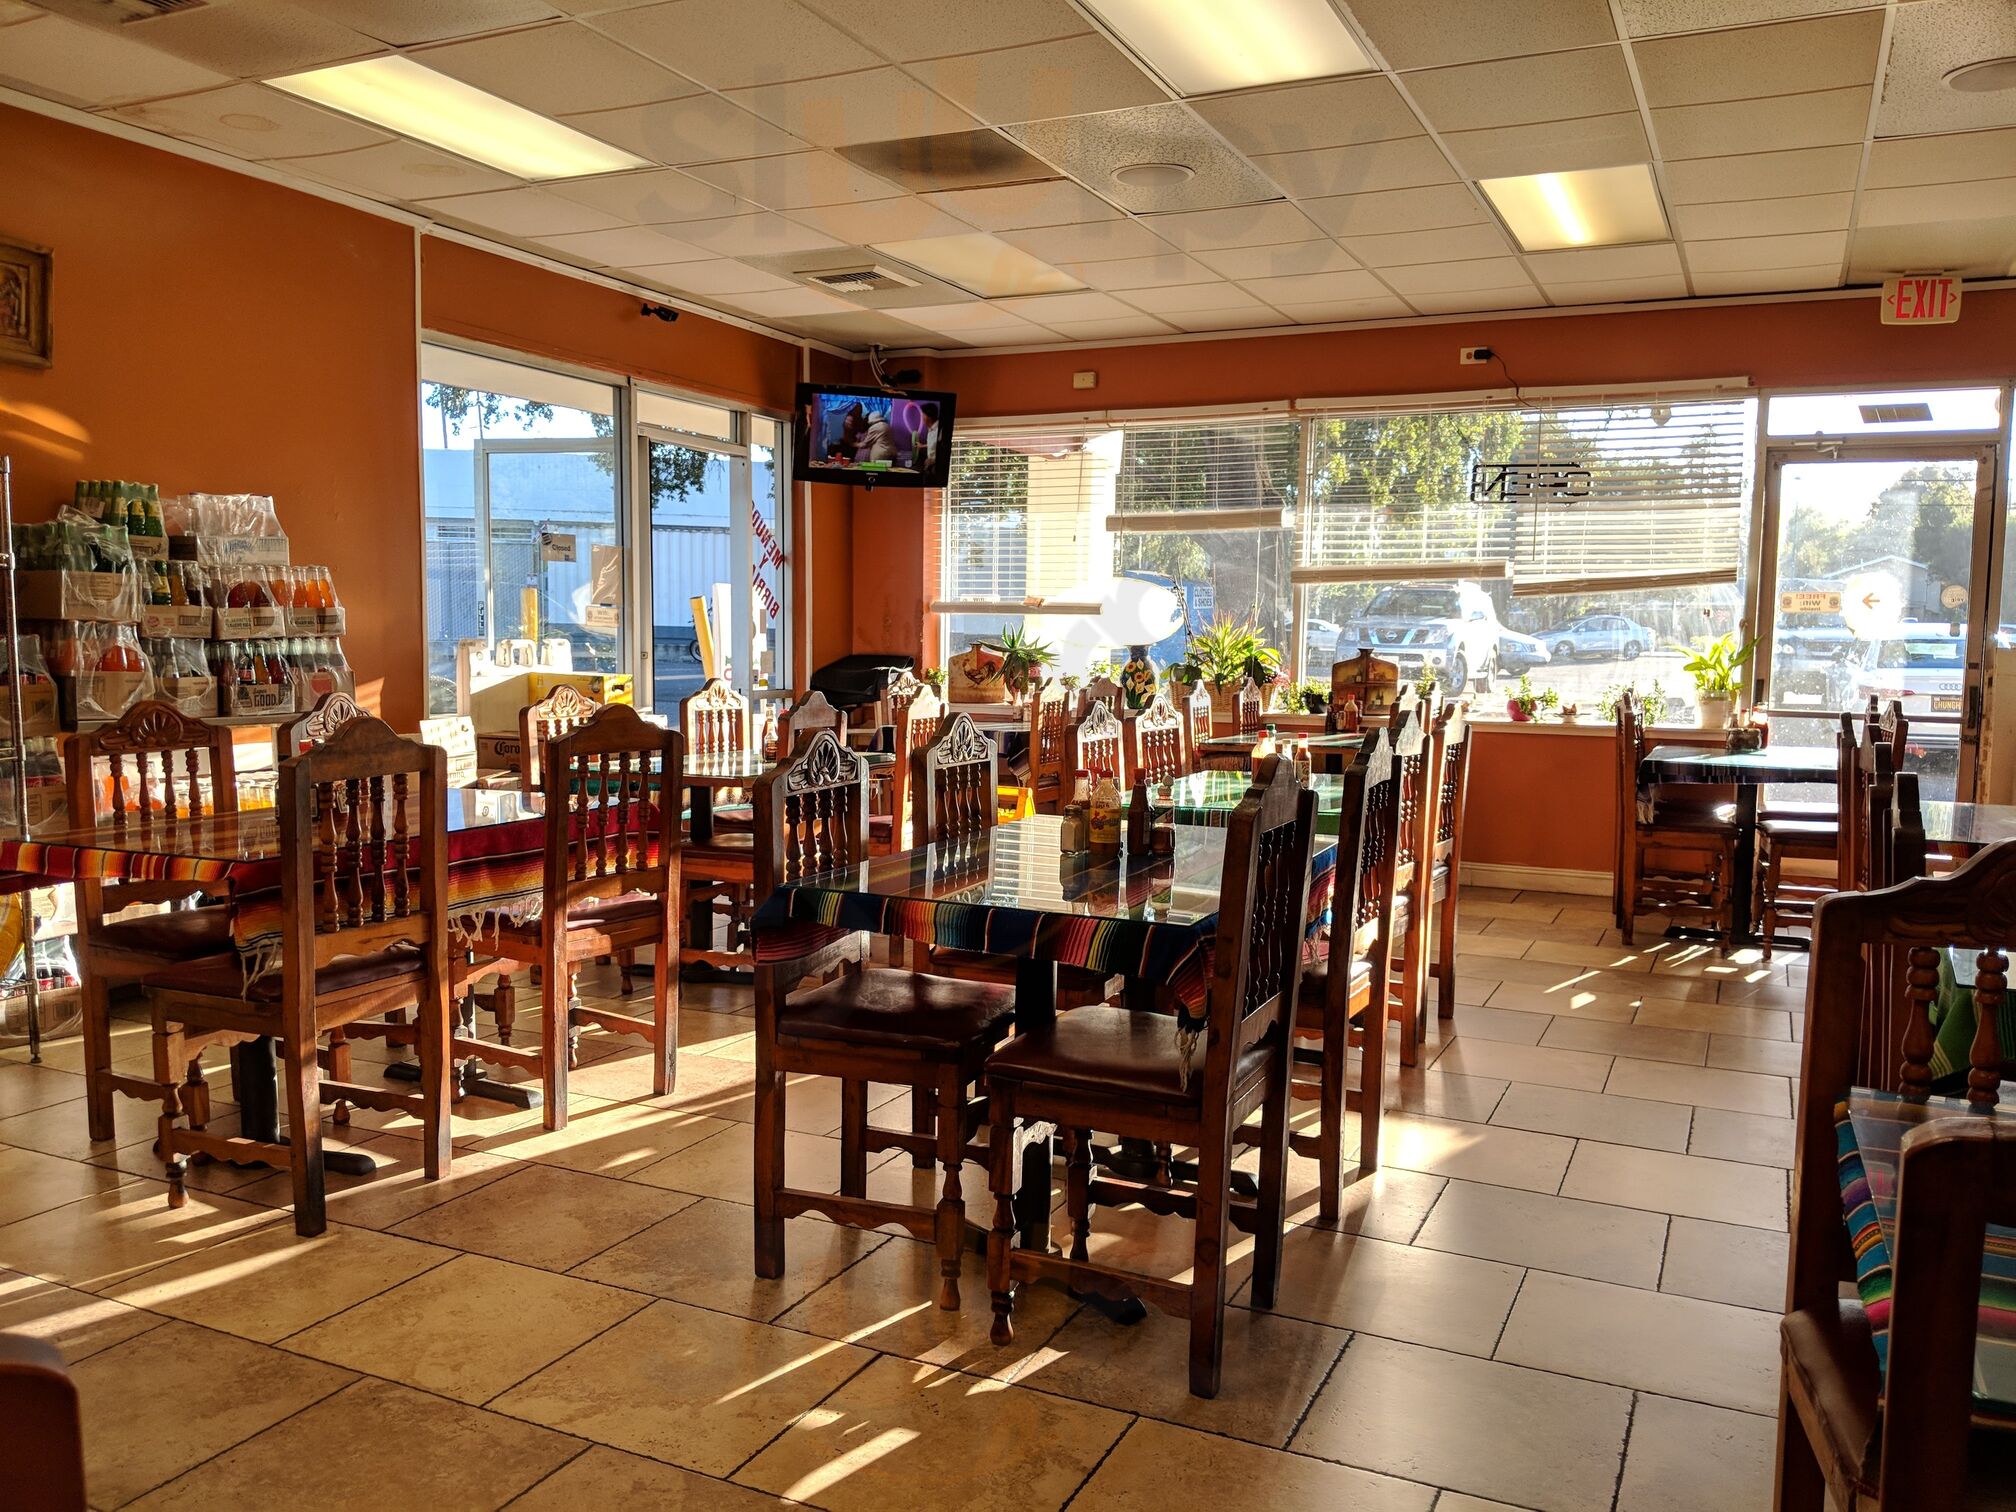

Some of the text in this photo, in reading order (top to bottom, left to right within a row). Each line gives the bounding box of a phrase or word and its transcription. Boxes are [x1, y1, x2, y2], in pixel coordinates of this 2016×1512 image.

[1896, 279, 1952, 319] EXIT
[551, 543, 571, 552] Closed
[1198, 598, 1213, 608] SHOES
